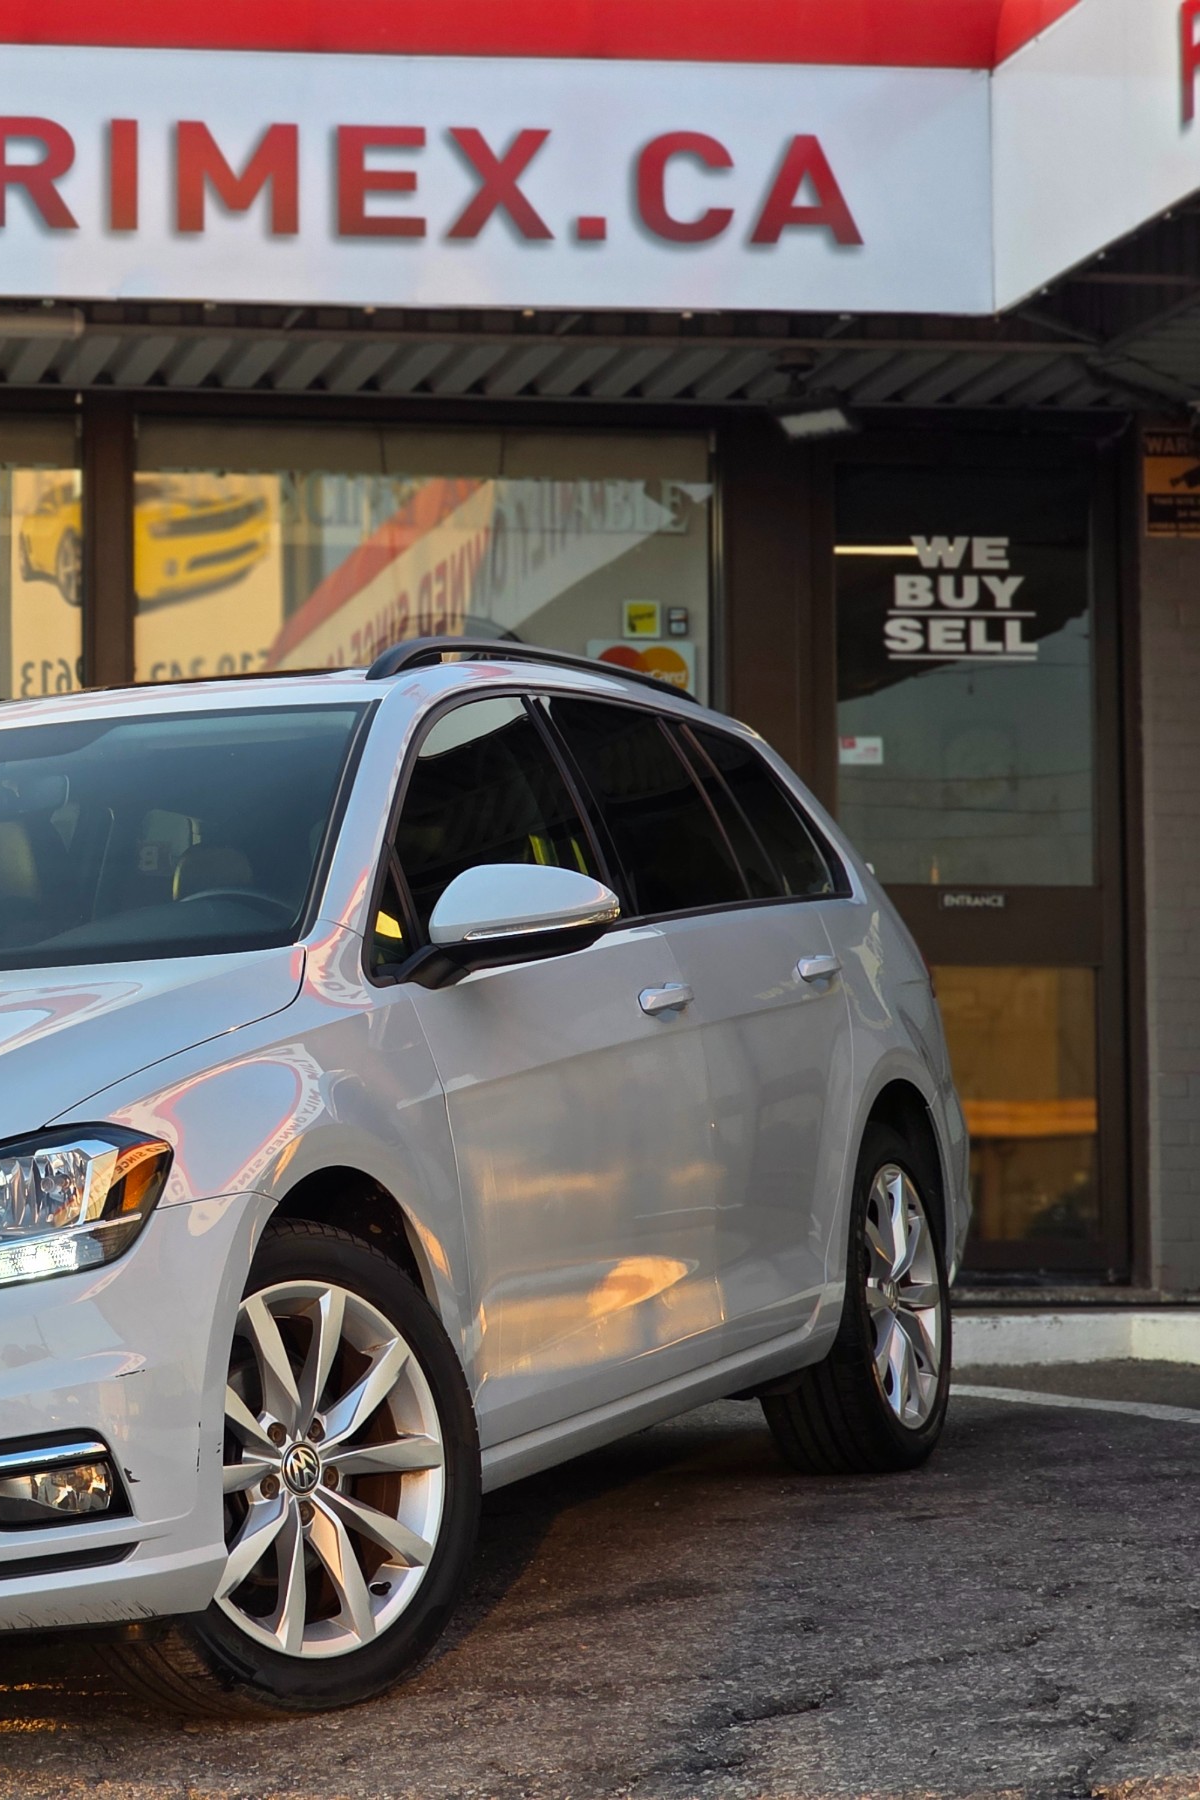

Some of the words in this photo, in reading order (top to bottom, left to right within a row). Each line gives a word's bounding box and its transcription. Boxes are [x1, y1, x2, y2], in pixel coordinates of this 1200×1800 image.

[910, 536, 1009, 569] WE
[894, 574, 1025, 608] BUY
[883, 618, 1039, 653] SELL
[943, 893, 1005, 907] ENTRANCE
